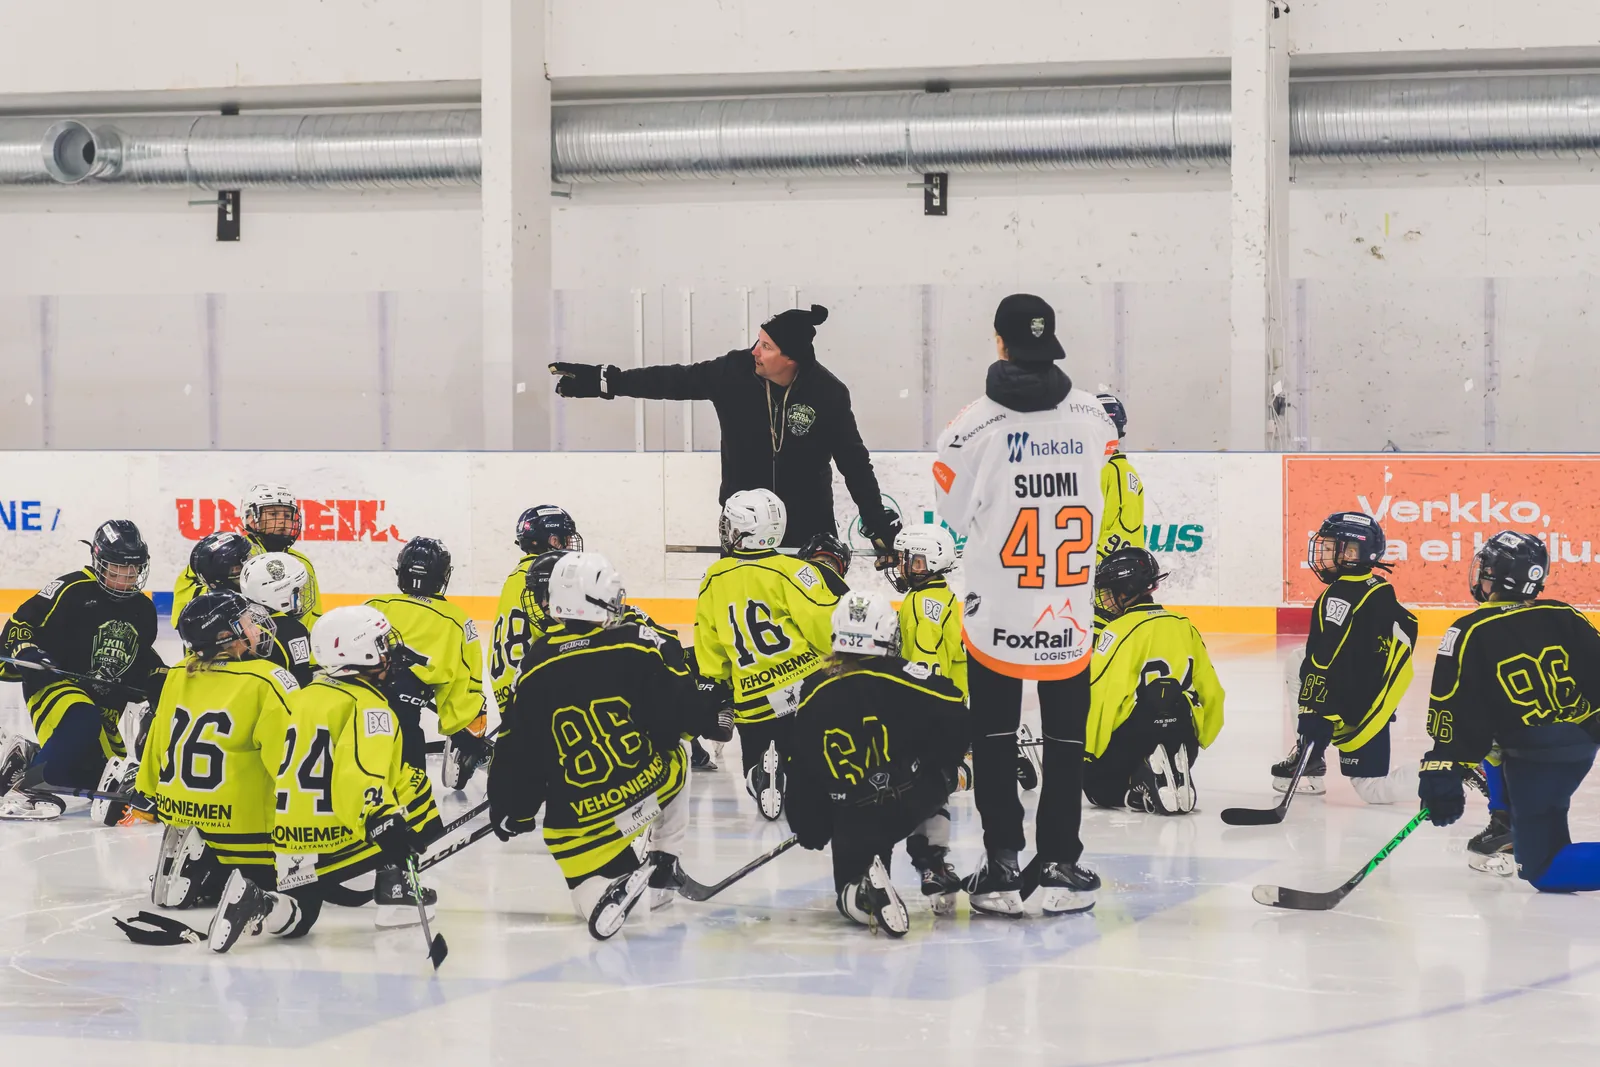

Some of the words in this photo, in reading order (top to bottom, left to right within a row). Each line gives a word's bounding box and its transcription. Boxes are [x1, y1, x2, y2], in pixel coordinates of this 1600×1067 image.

[1030, 438, 1084, 457] hakala
[1014, 471, 1079, 498] SUOMI
[1356, 492, 1551, 527] Verkko,
[999, 505, 1094, 589] 42
[1143, 523, 1205, 553] us
[1418, 532, 1462, 562] ei
[412, 578, 421, 589] 11
[1521, 582, 1537, 595] 16
[728, 598, 791, 669] 16
[848, 634, 864, 647] 32
[993, 628, 1073, 650] FoxRail
[1034, 648, 1083, 661] LOGISTICS
[740, 647, 819, 691] VEHONIEMEN
[1300, 673, 1328, 703] 87
[399, 693, 429, 708] CCM
[272, 825, 354, 843] ONIEMEN
